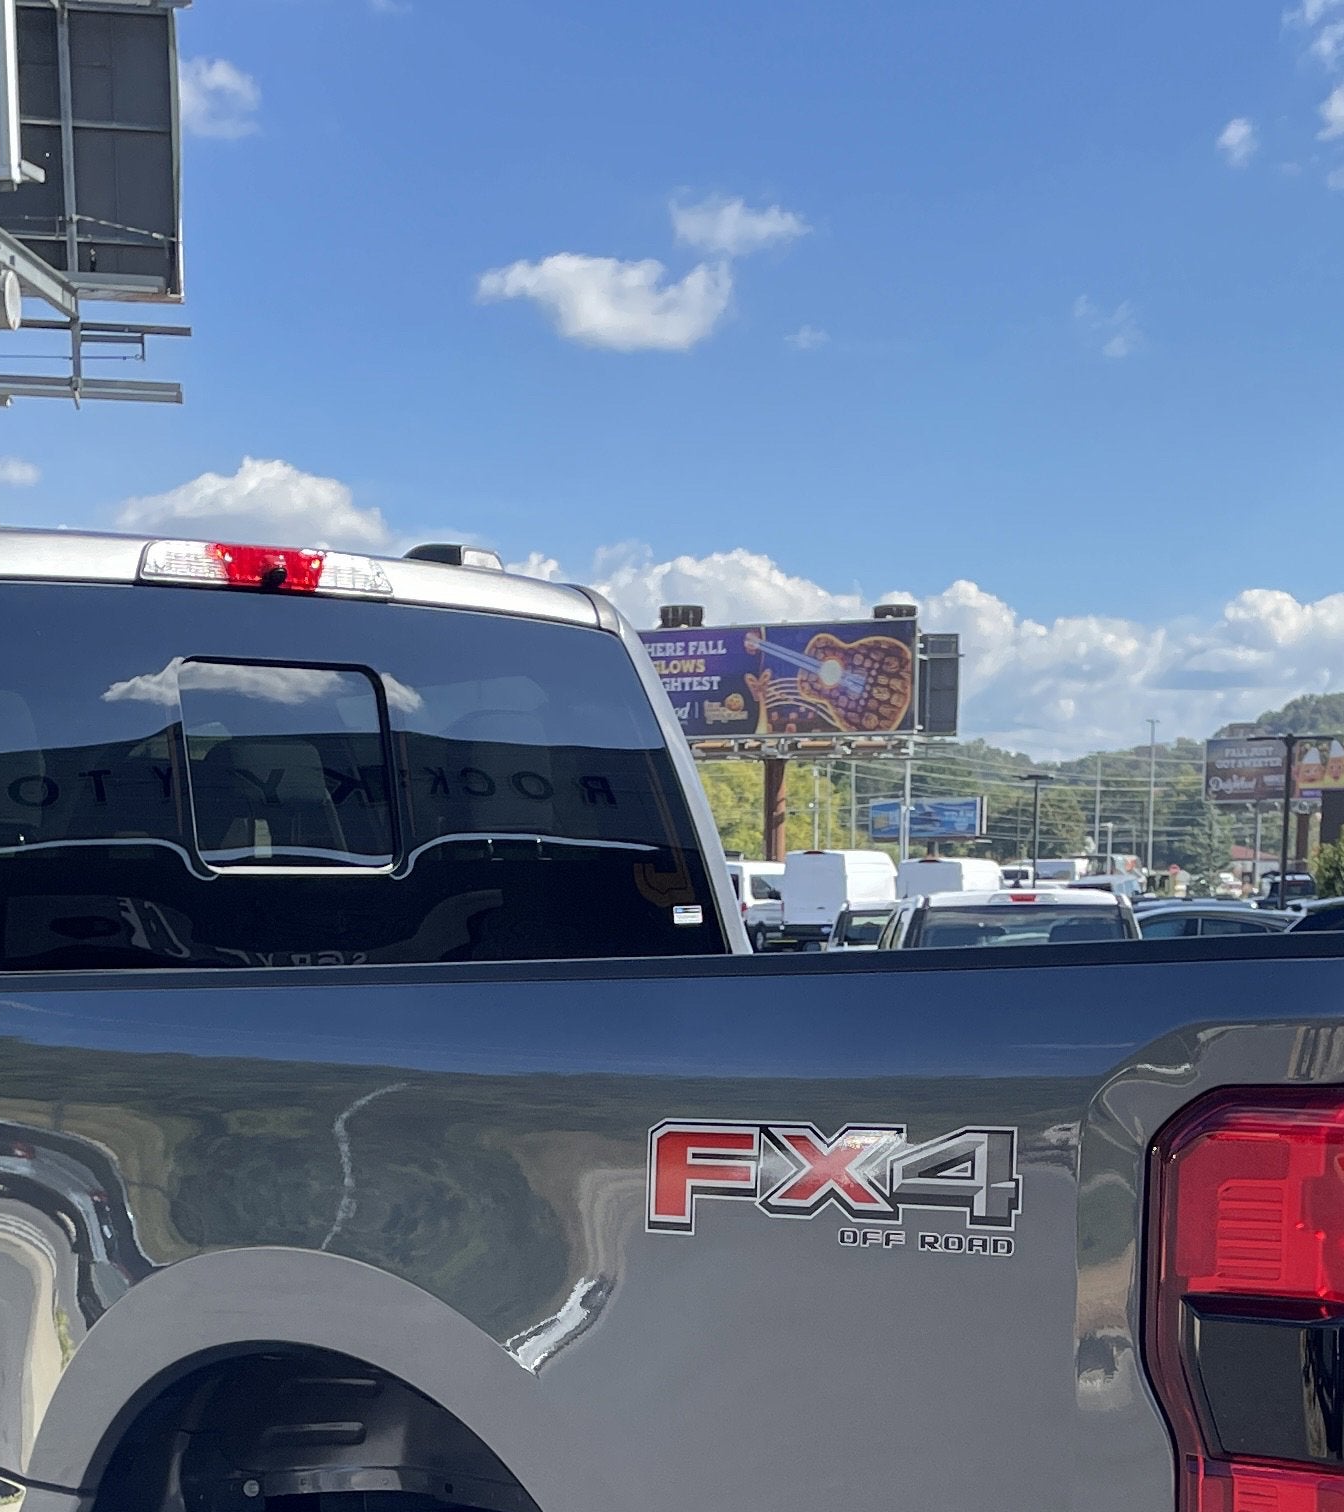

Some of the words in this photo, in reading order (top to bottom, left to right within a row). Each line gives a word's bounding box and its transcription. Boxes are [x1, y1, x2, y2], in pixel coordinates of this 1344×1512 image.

[644, 642, 686, 657] HERE
[687, 640, 727, 656] FALL
[645, 1117, 1023, 1236] FX4
[838, 1227, 906, 1249] OFF
[917, 1231, 1016, 1257] ROAD
